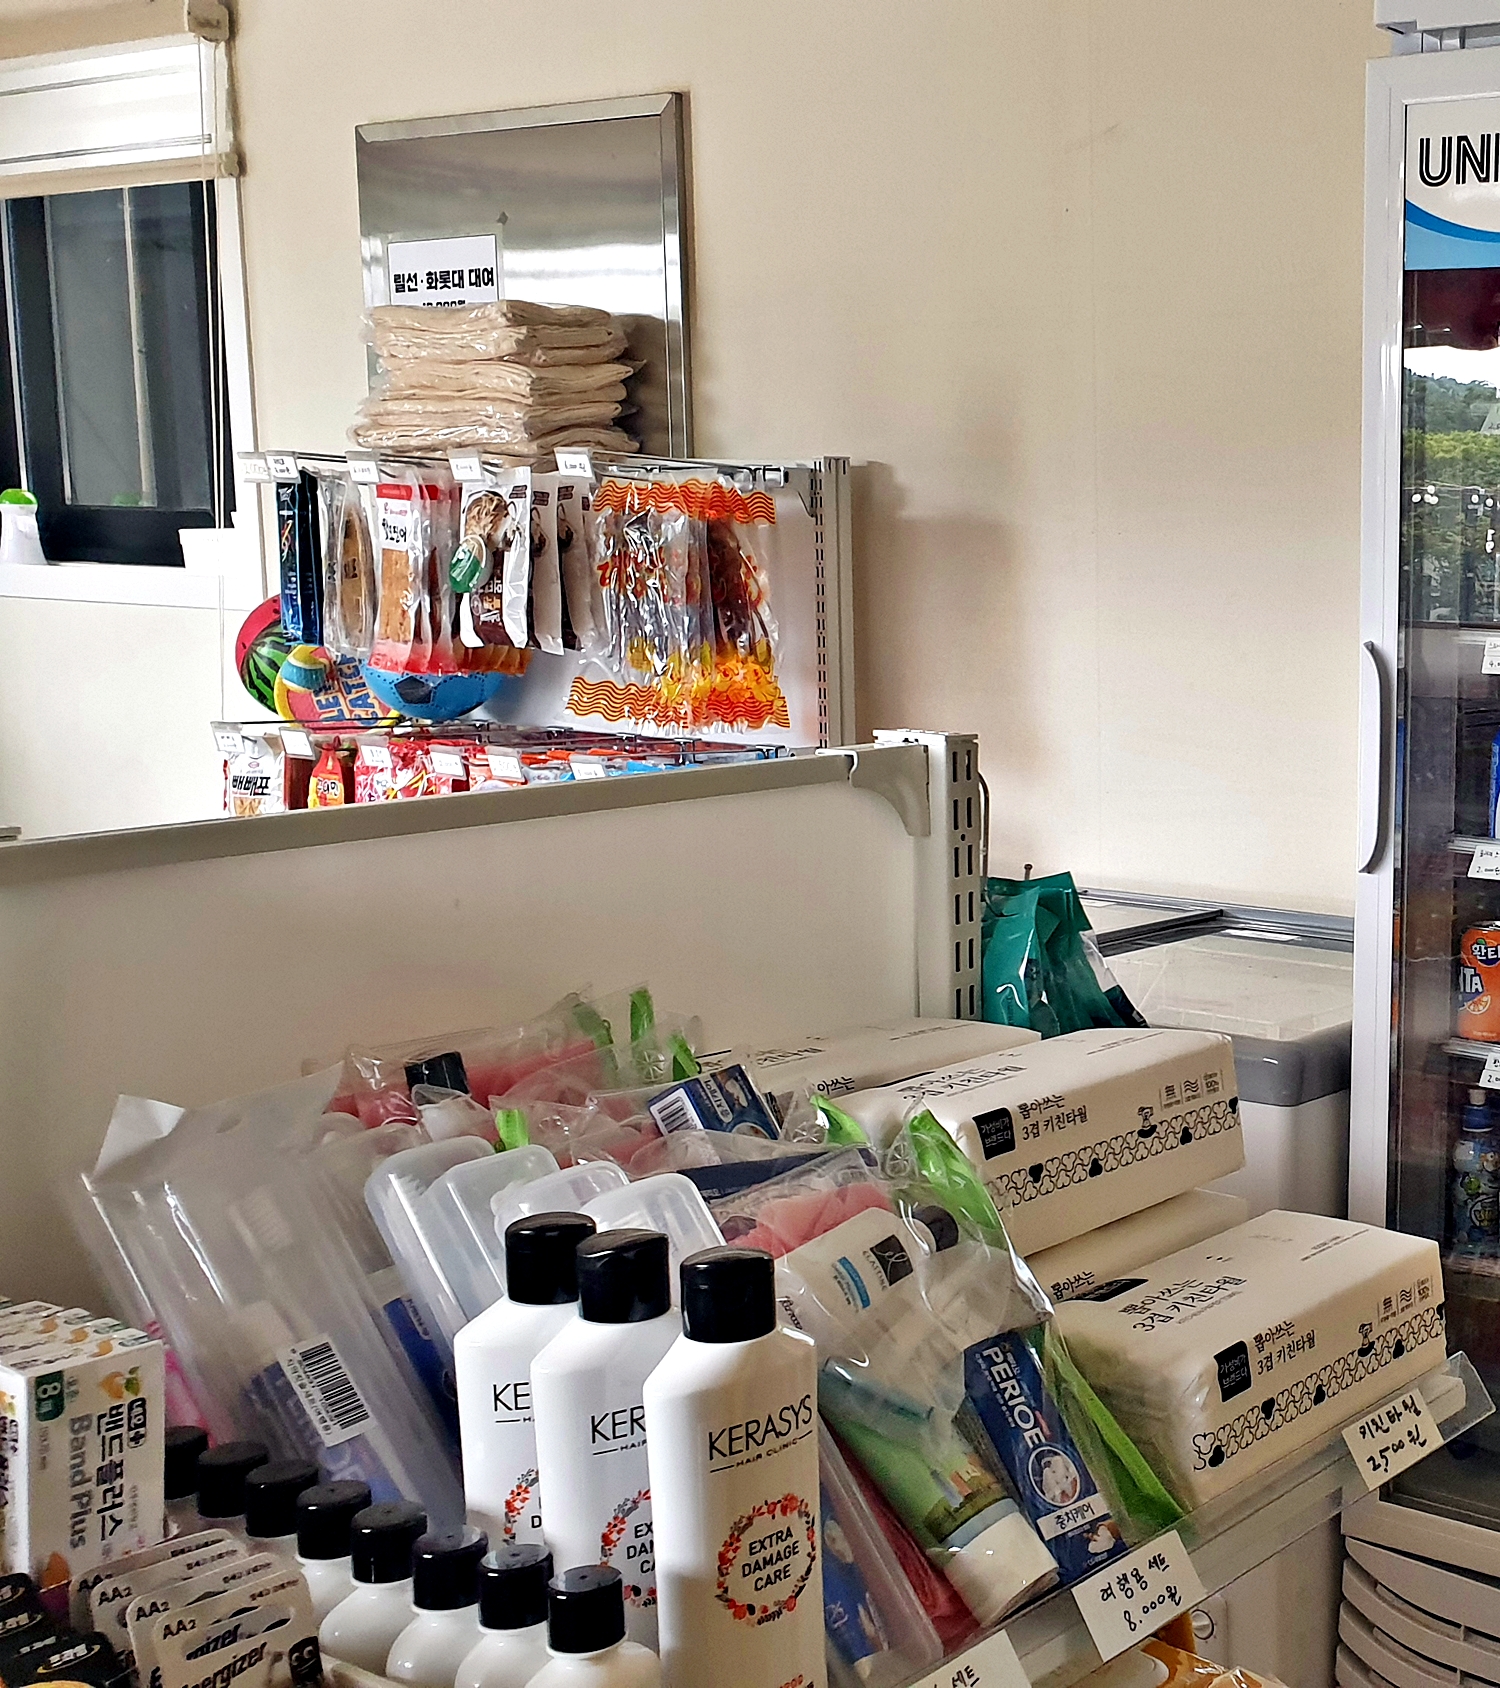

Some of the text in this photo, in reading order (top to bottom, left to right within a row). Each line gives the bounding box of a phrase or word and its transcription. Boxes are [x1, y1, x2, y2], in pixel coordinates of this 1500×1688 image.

[468, 266, 495, 288] 대여
[817, 1076, 856, 1096] 아쓰는
[1016, 1093, 1065, 1120] 뽑아쓰는
[1021, 1104, 1089, 1142] 3겹 키친타월
[1252, 1319, 1296, 1351] 뽑아쓰는
[1256, 1329, 1318, 1377] 3겹 키친타월
[981, 1345, 1046, 1449] PERIOE
[708, 1394, 815, 1461] KERASYS
[1358, 1395, 1422, 1441] 키친타월
[735, 1438, 799, 1469] HAIR CLINIC
[69, 1413, 93, 1549] Band Plus
[1053, 1502, 1097, 1530] 충치케어
[740, 1539, 801, 1579] DAMAGE
[748, 1526, 795, 1557] EXTRA
[753, 1565, 793, 1592] CARE
[1099, 1552, 1171, 1604] 여행용 세트
[1123, 1584, 1184, 1633] 8.000원
